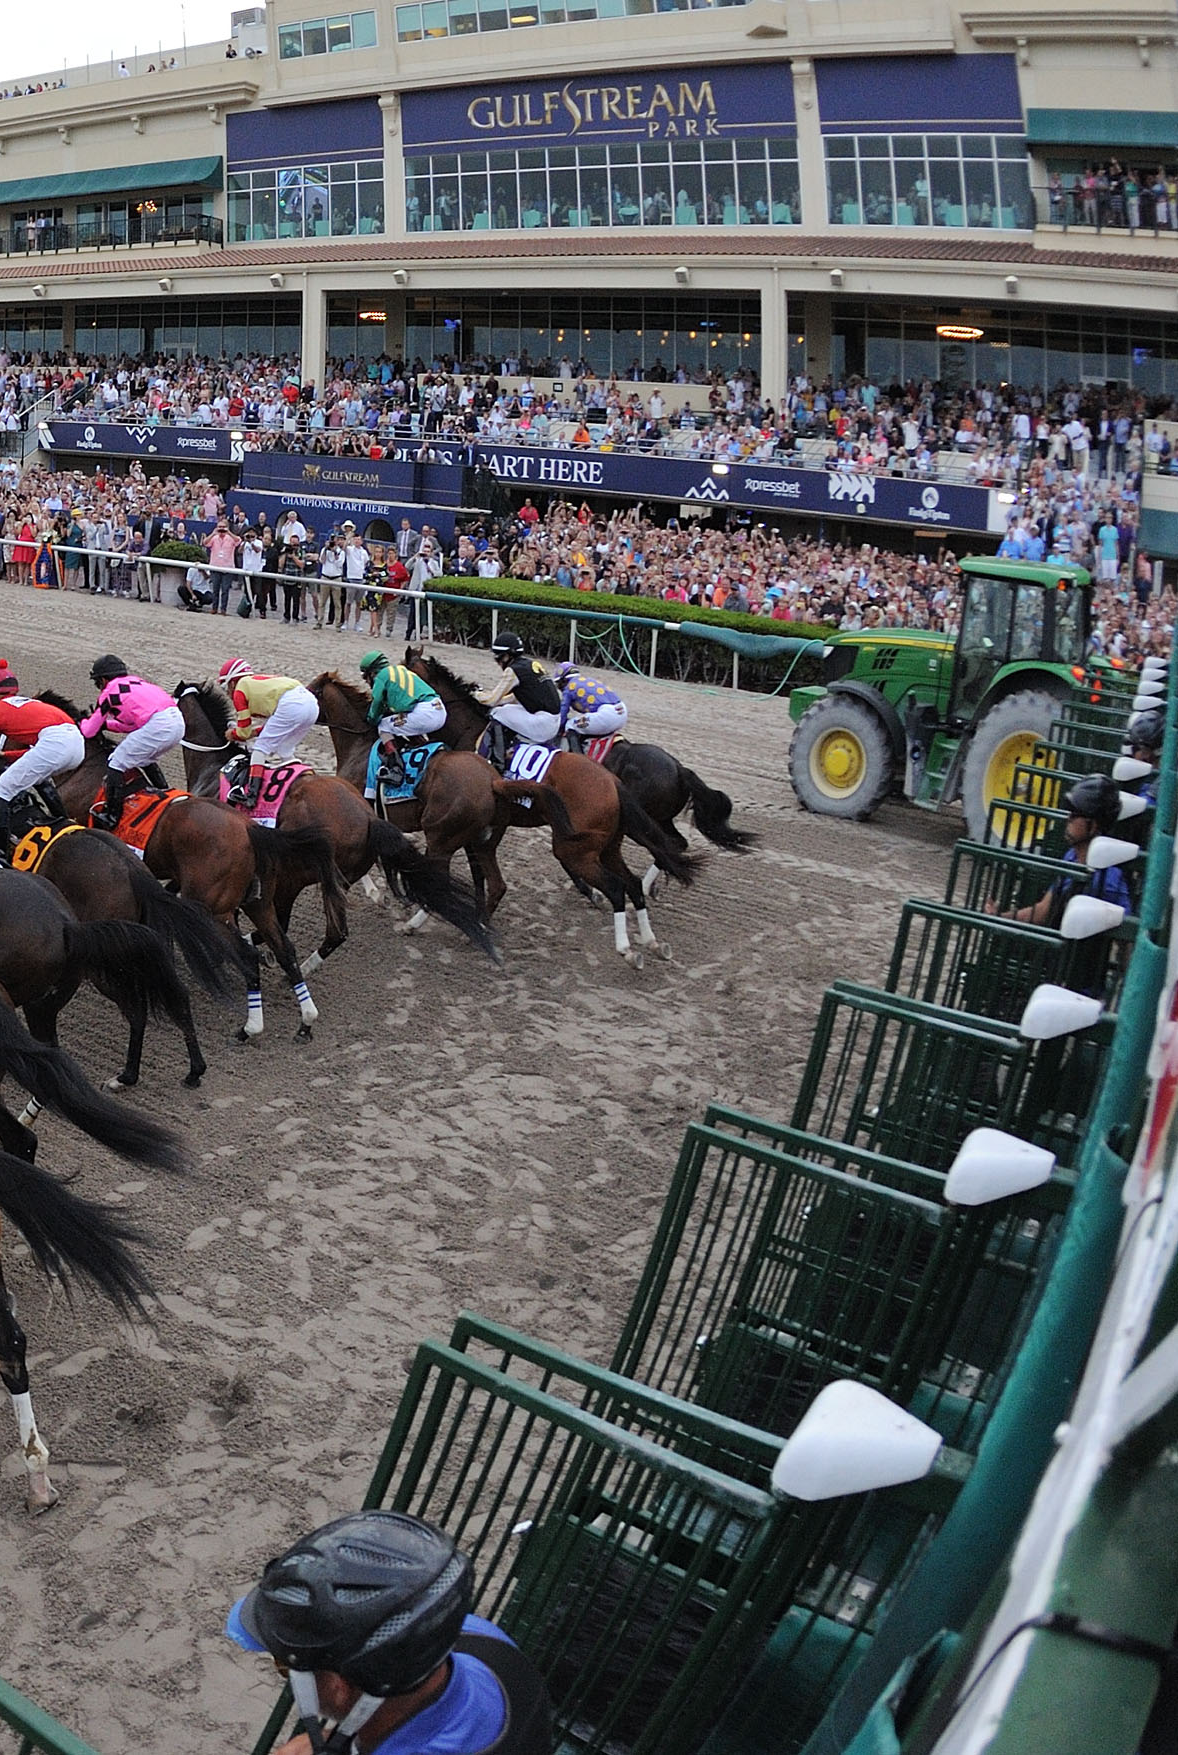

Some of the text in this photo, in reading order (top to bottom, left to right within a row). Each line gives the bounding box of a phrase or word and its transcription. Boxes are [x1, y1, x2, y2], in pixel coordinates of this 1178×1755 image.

[467, 80, 718, 136] GULFSTREAM
[648, 118, 719, 138] PARK
[322, 470, 380, 482] GULFSTREAM
[539, 457, 604, 484] HERE
[281, 496, 390, 515] CHAMPIONS START HERE
[405, 748, 430, 785] 9
[510, 743, 550, 780] 10
[263, 768, 295, 802] 8
[11, 826, 52, 872] 6
